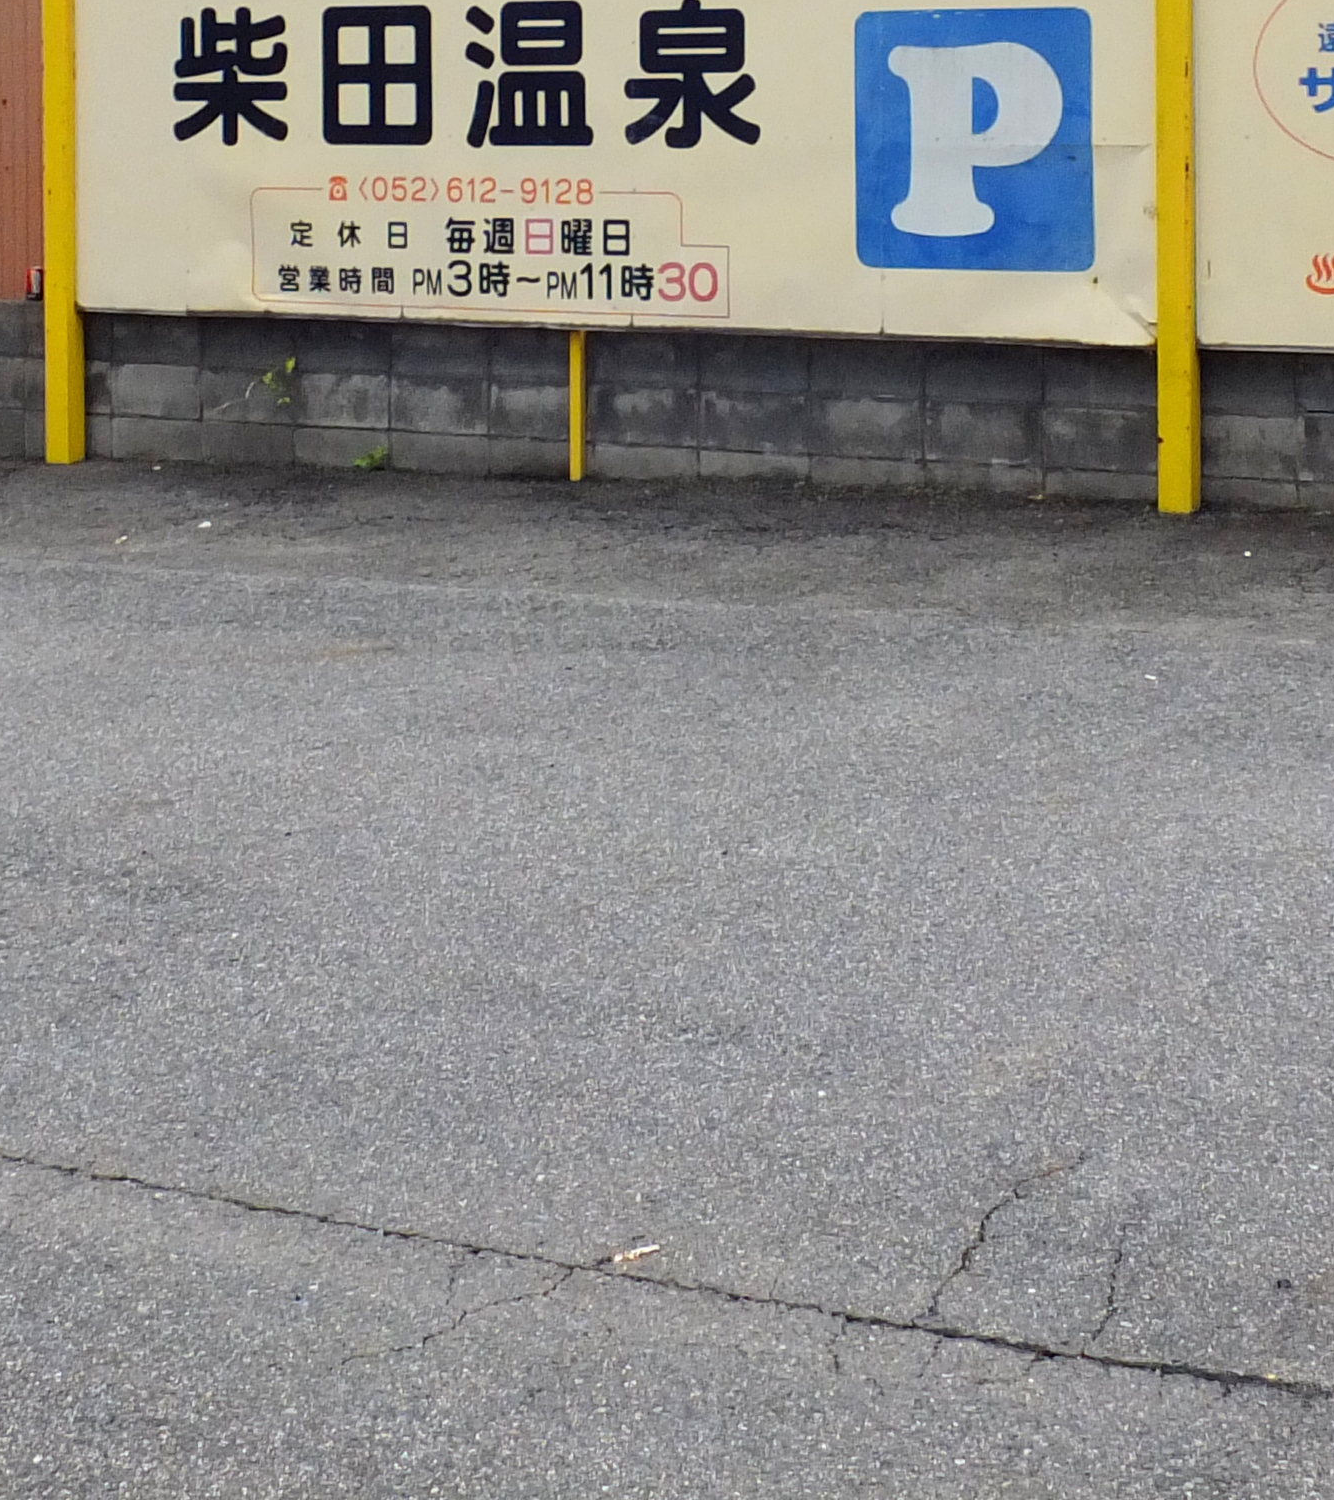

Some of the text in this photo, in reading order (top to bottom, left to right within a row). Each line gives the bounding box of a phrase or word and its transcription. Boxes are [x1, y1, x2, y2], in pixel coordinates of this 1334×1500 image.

[888, 41, 1063, 237] P
[289, 216, 631, 257] 定休日 毎週日曜日
[277, 264, 395, 295] 営業時間
